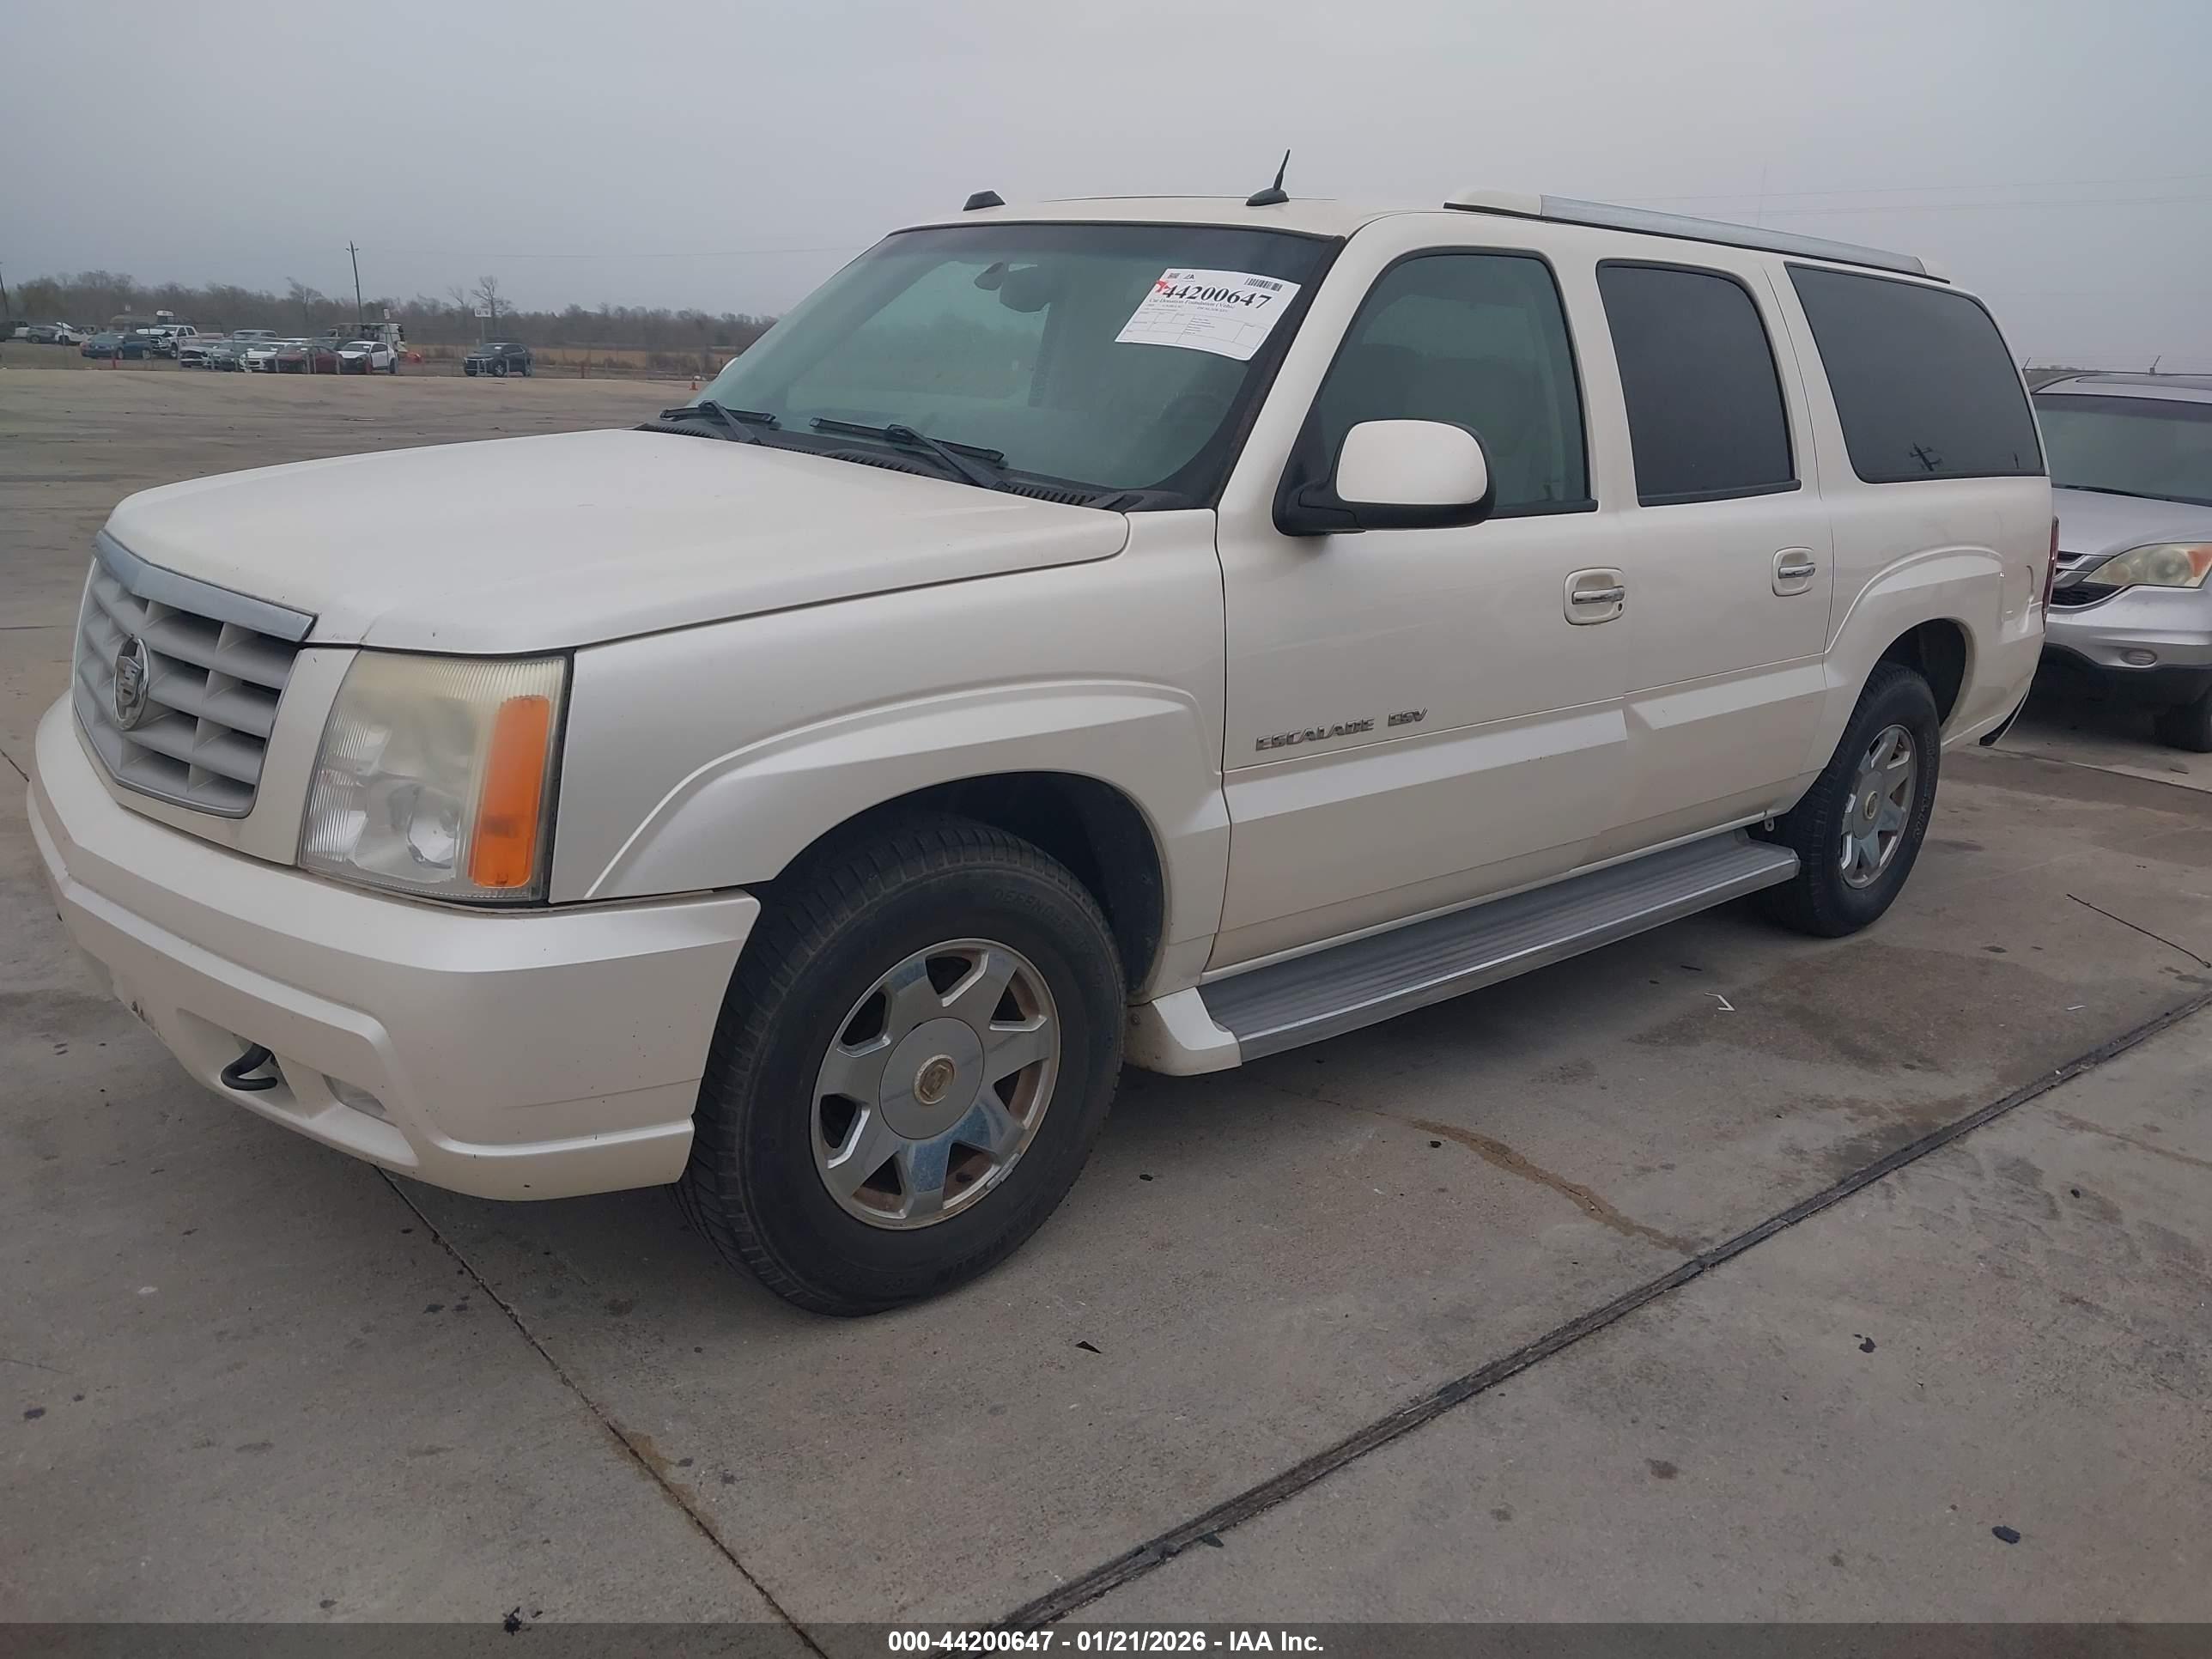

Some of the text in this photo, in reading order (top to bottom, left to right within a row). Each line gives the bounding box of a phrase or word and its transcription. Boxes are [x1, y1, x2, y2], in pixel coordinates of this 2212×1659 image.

[1163, 285, 1273, 309] 44200647
[1255, 707, 1428, 751] ESCALADE ESV
